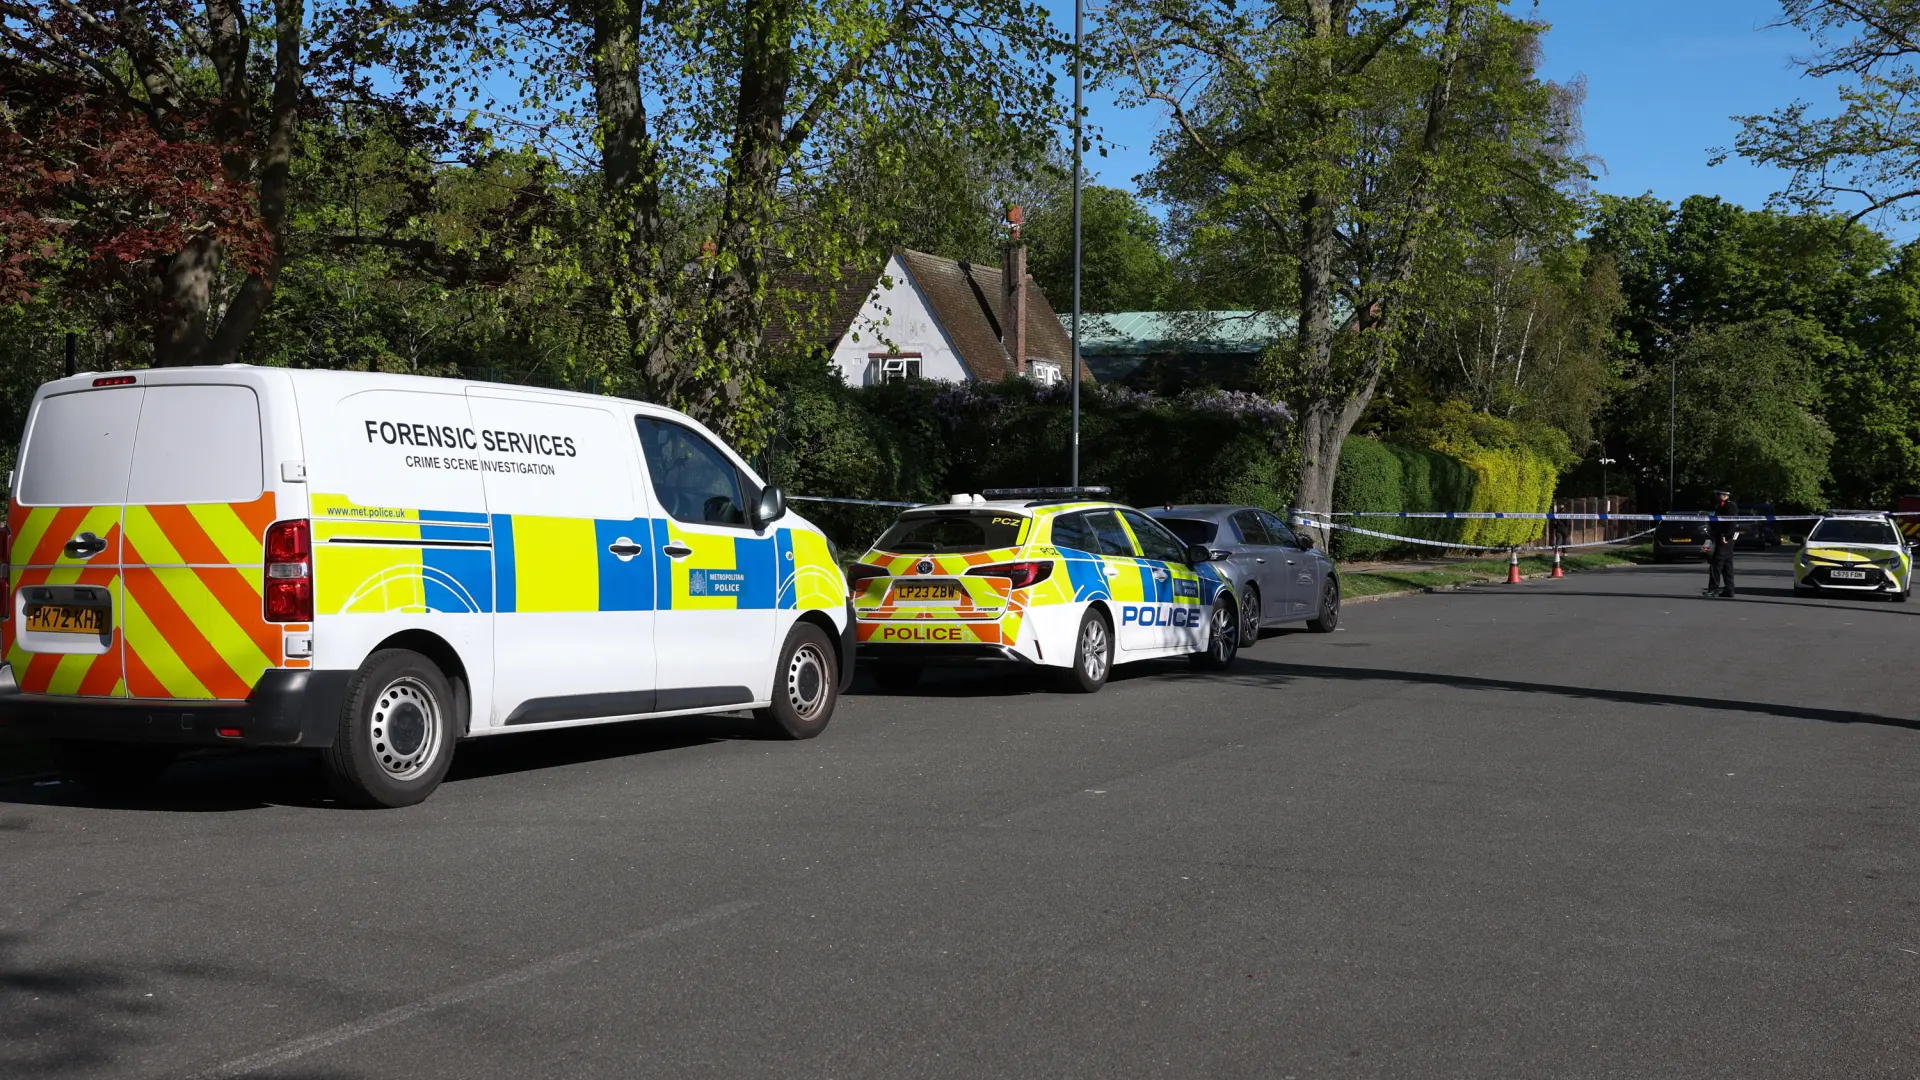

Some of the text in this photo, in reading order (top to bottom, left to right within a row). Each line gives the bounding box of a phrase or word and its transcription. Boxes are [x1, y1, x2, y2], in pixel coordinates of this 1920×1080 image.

[364, 420, 577, 458] FORENSIC SERVICES
[405, 455, 555, 476] CRIME SCENE INVESTIGATION
[327, 506, 405, 518] www.met.police.uk
[992, 517, 1021, 527] PCZ
[709, 573, 744, 581] METROPOLITAN
[714, 583, 740, 591] POLICE
[899, 585, 956, 598] LP23 ZBW
[32, 607, 104, 630] PK72 KHB
[1122, 605, 1201, 628] POLICE
[884, 627, 962, 641] POLICE
